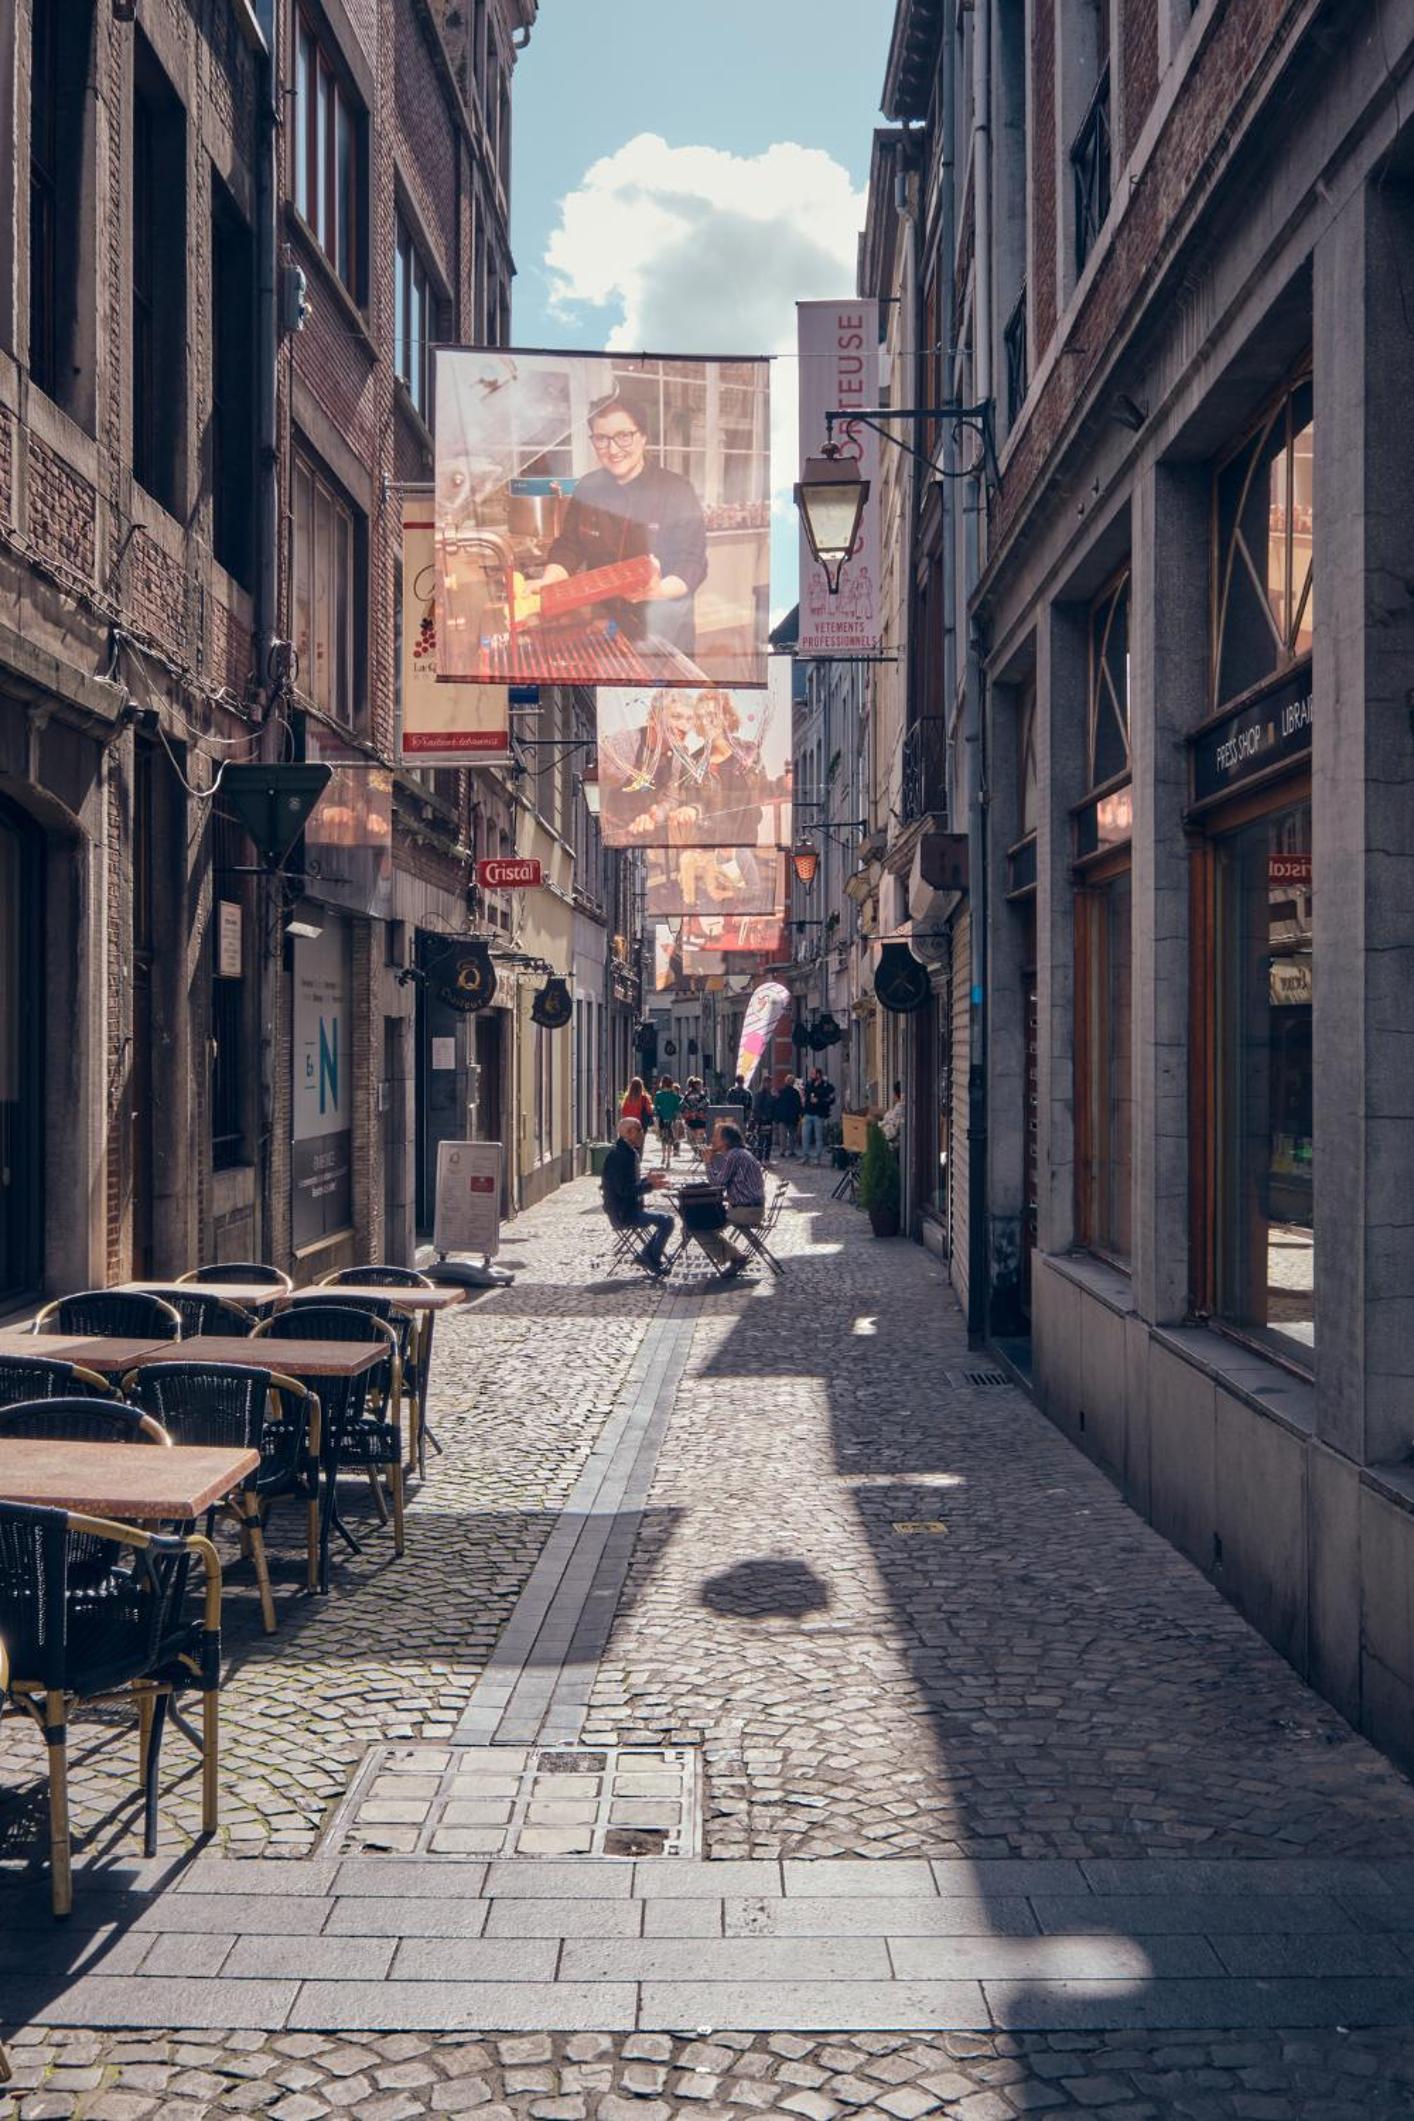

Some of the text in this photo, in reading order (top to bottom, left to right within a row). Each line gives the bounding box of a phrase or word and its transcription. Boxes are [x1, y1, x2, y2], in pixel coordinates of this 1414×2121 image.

[802, 634, 877, 648] PROFESSIONNELS
[1216, 738, 1238, 773] PRESS
[1238, 725, 1261, 761] SHOP
[485, 862, 534, 884] Cristal
